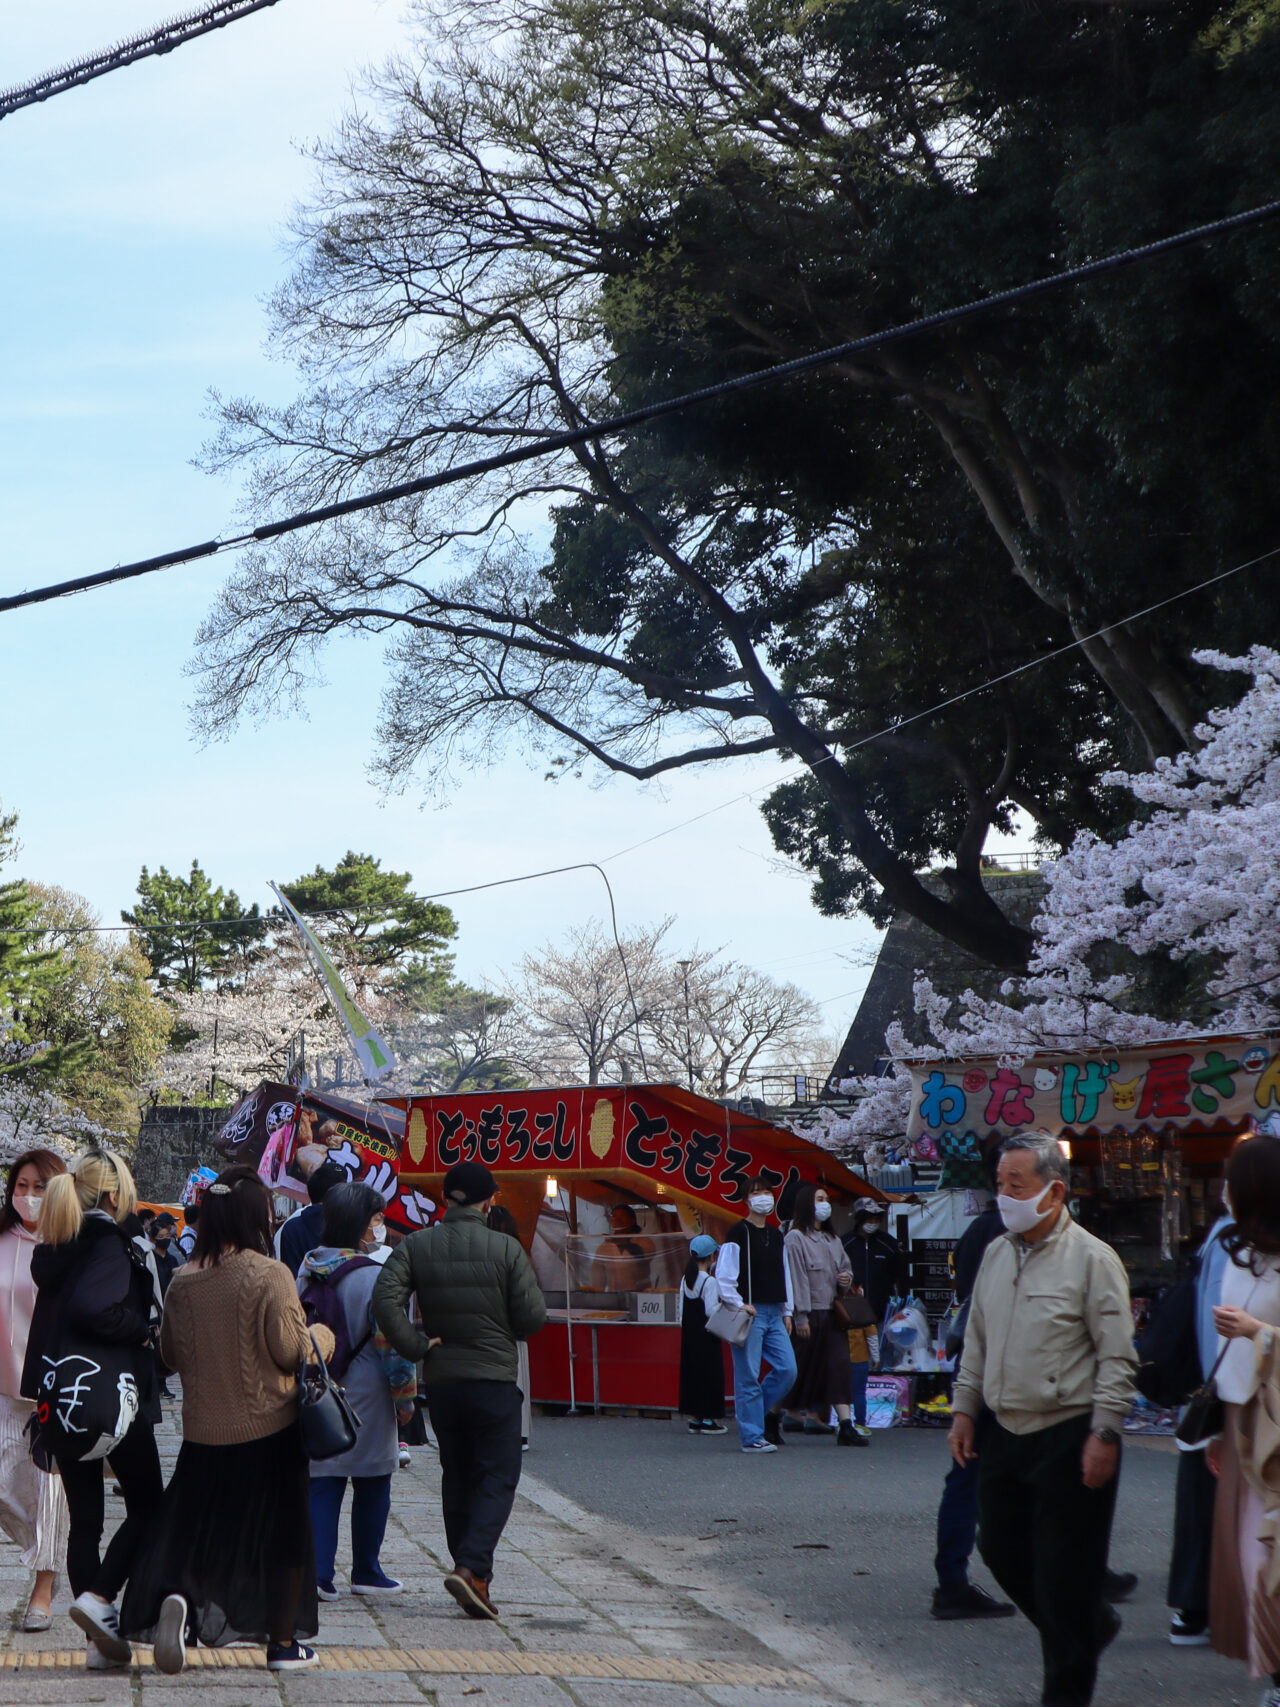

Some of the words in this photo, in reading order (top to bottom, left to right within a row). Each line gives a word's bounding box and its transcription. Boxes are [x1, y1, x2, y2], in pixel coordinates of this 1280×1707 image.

[437, 1101, 575, 1165] とうもろこし
